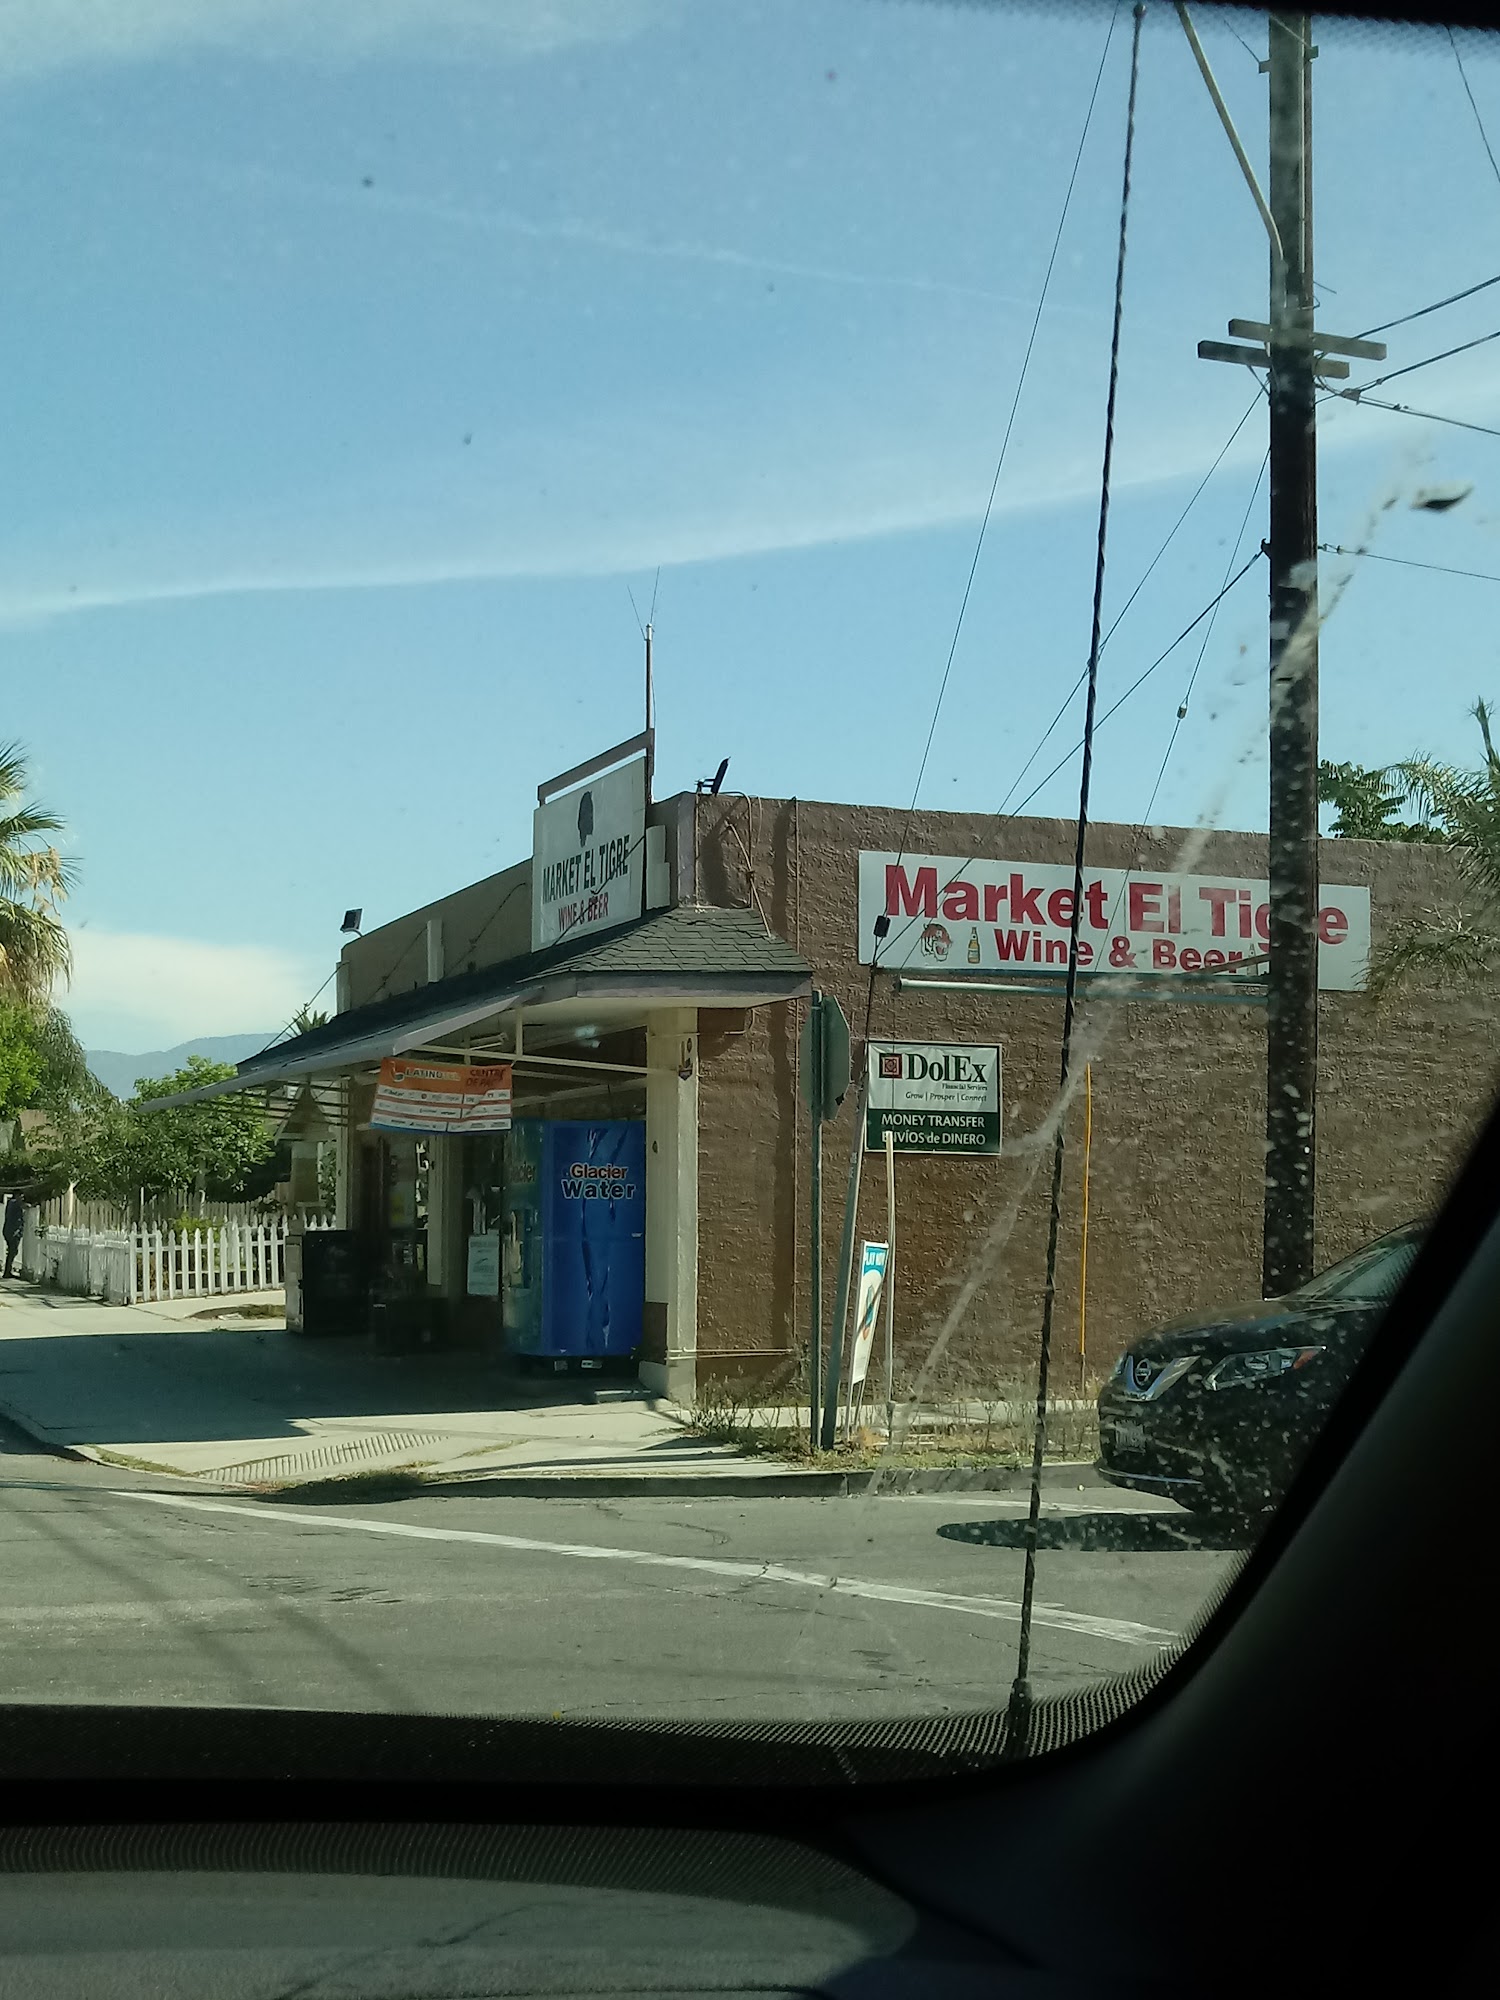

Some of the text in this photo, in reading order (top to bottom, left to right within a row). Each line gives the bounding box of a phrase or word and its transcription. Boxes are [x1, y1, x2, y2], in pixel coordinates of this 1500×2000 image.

[542, 834, 630, 905] MARKET EL TIGRE
[558, 891, 609, 932] WINE & BEER
[884, 864, 1349, 953] Market El Tie
[993, 927, 1243, 974] Wine & Beer
[905, 1052, 987, 1083] DolEx
[905, 1091, 987, 1102] Grow Prosper Connect
[967, 1083, 988, 1091] Services
[881, 1113, 985, 1128] MONEY TRANSFER
[926, 1131, 940, 1144] de
[942, 1132, 986, 1145] DINERO
[570, 1162, 628, 1180] Glacier
[561, 1179, 636, 1200] Water
